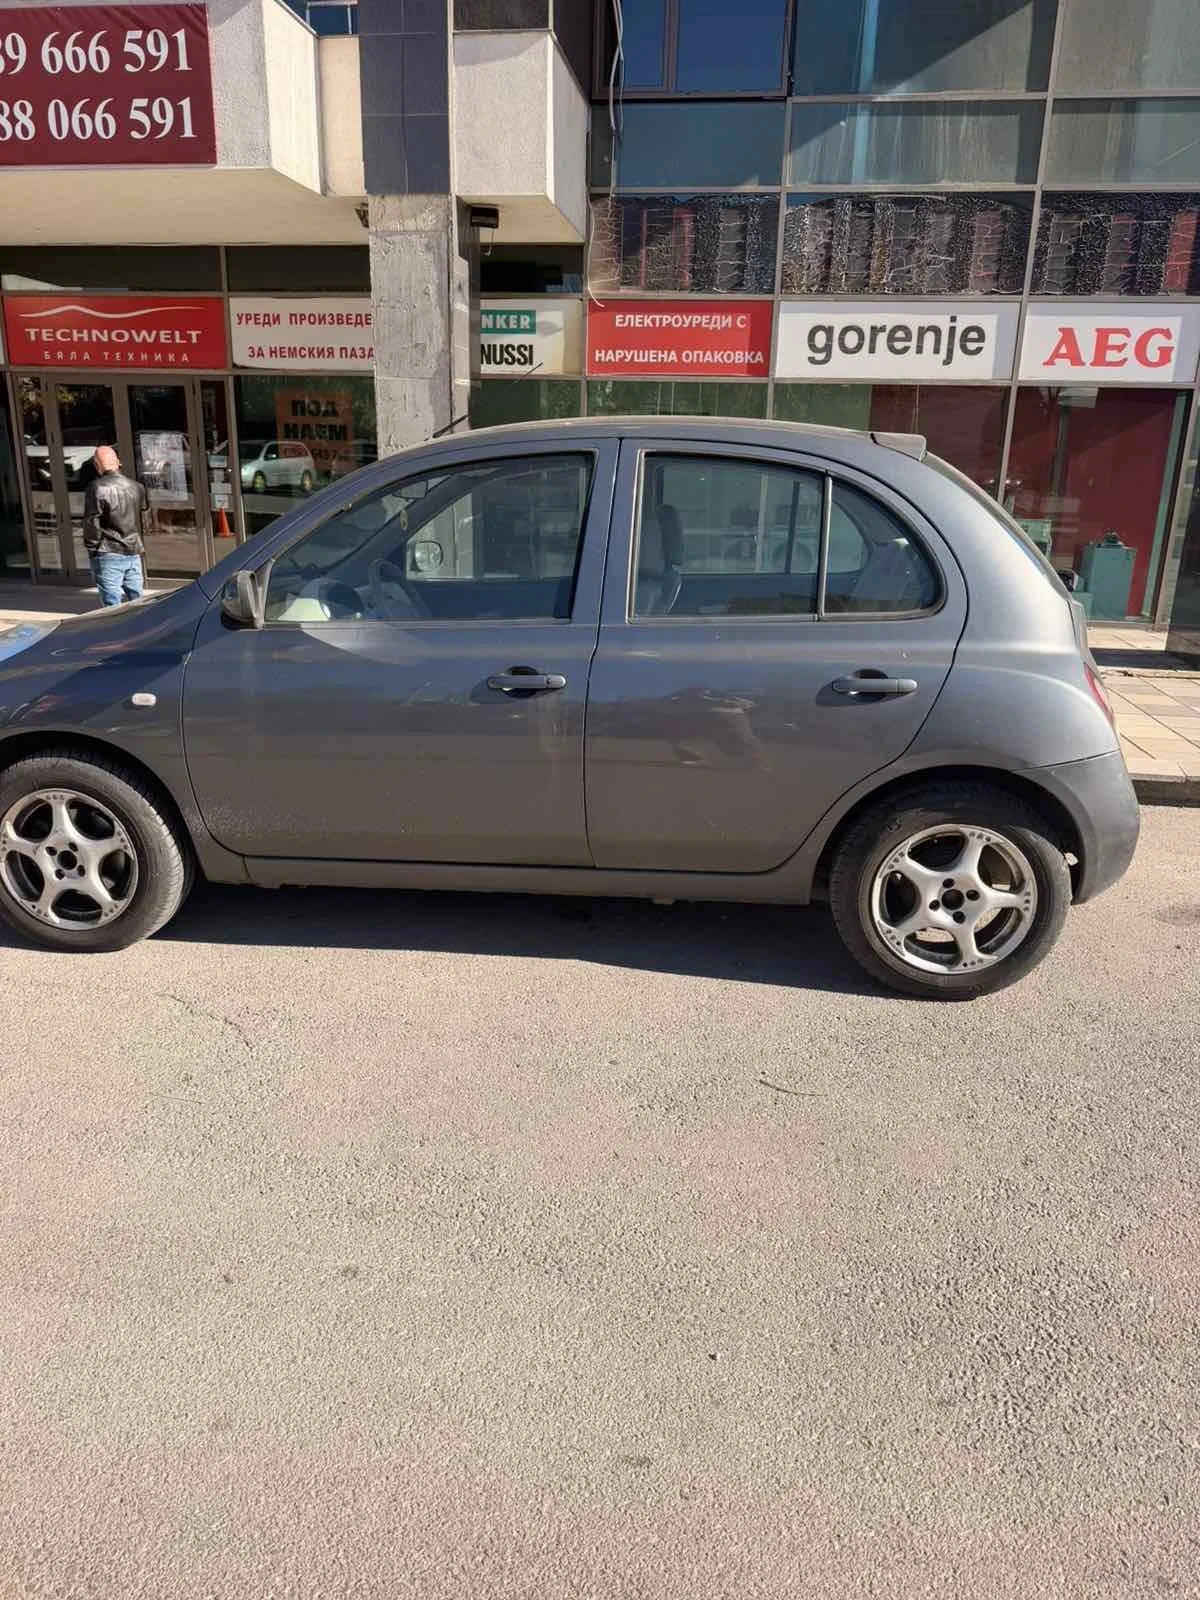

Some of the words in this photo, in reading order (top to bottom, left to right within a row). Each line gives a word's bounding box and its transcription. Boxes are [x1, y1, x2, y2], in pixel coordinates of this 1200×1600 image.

[0, 32, 27, 75] 9
[41, 30, 110, 74] 666
[123, 28, 193, 73] 591
[48, 97, 117, 140] 066
[129, 96, 198, 140] 591
[236, 313, 281, 328] УРЕДИ
[615, 314, 732, 330] ЕЛЕКТРОУРЕДИ
[736, 315, 747, 329] С
[25, 328, 202, 344] TECHNOWELT
[806, 315, 986, 366] gorenje
[248, 346, 265, 359] ЗА
[269, 346, 335, 359] НЕМСКИЯ
[480, 343, 533, 366] NUSSI
[1042, 327, 1174, 368] AEG
[43, 351, 91, 361] БЯЛА
[103, 352, 190, 362] ТЕХНИКА
[595, 349, 678, 363] НАРУШЕНА
[682, 350, 764, 364] ОПАКОВКА
